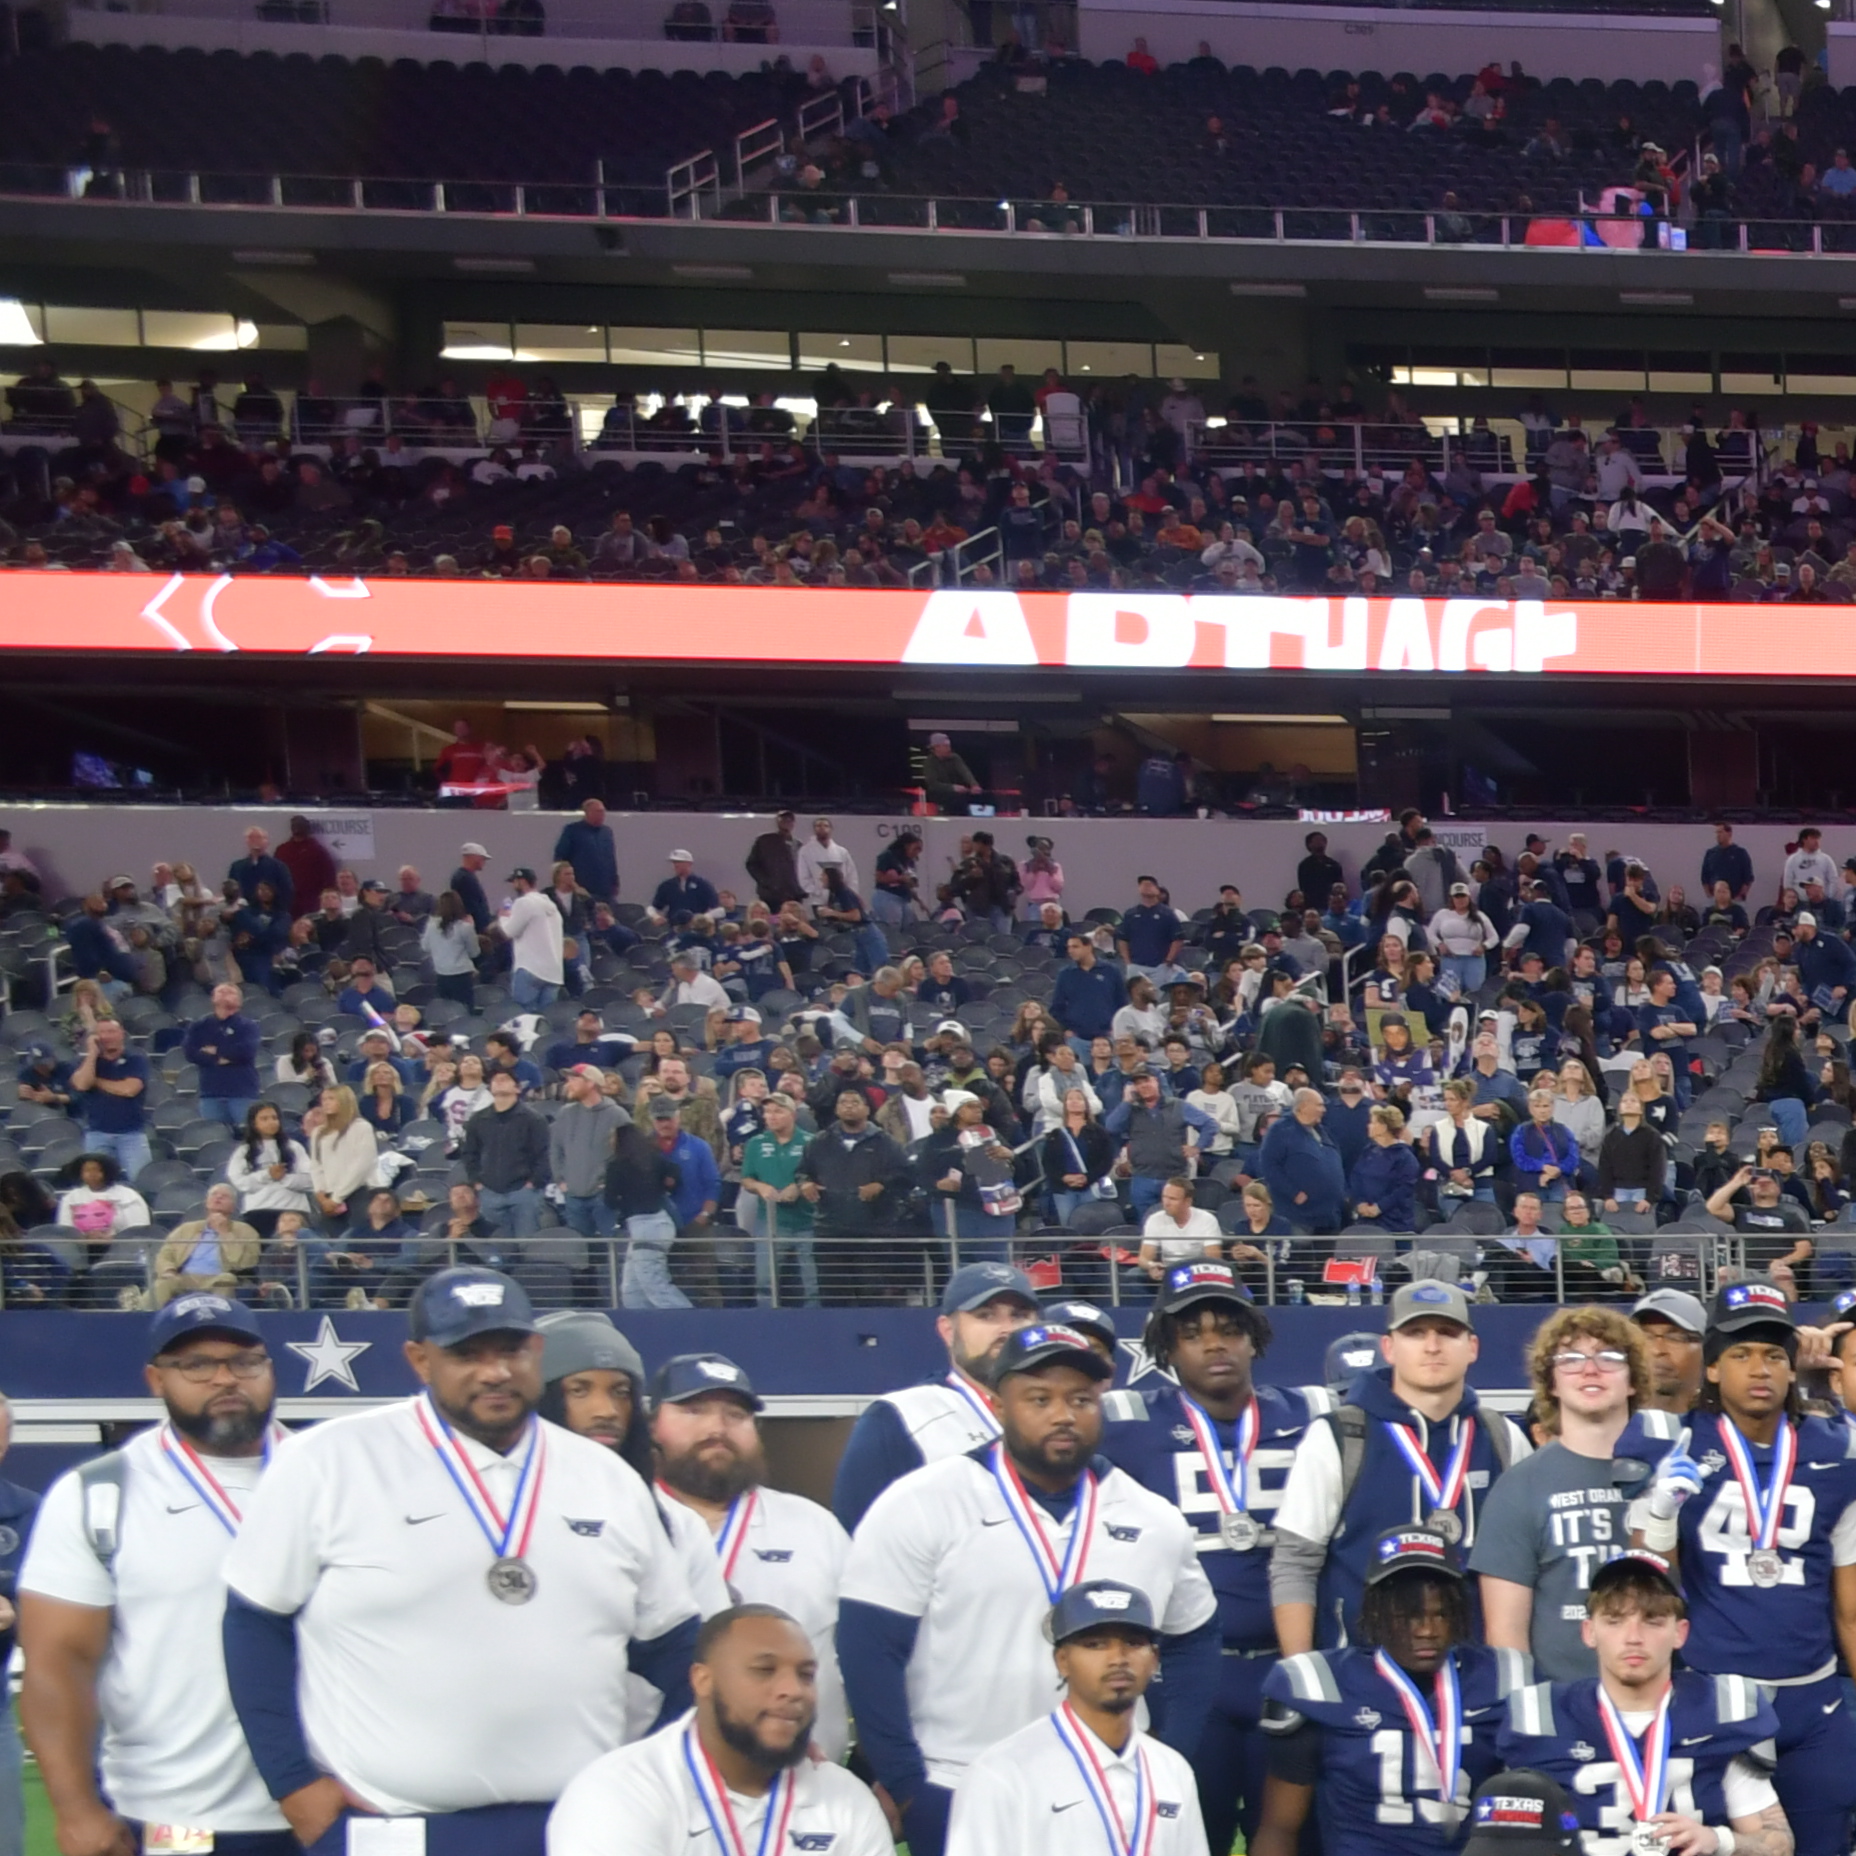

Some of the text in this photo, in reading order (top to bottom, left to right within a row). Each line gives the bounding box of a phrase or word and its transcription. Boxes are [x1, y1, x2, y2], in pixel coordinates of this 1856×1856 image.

[1587, 1487, 1624, 1505] ORAN
[1551, 1506, 1613, 1546] IT'S
[1562, 1604, 1590, 1620] 202
[1493, 1795, 1544, 1814] TEXAS
